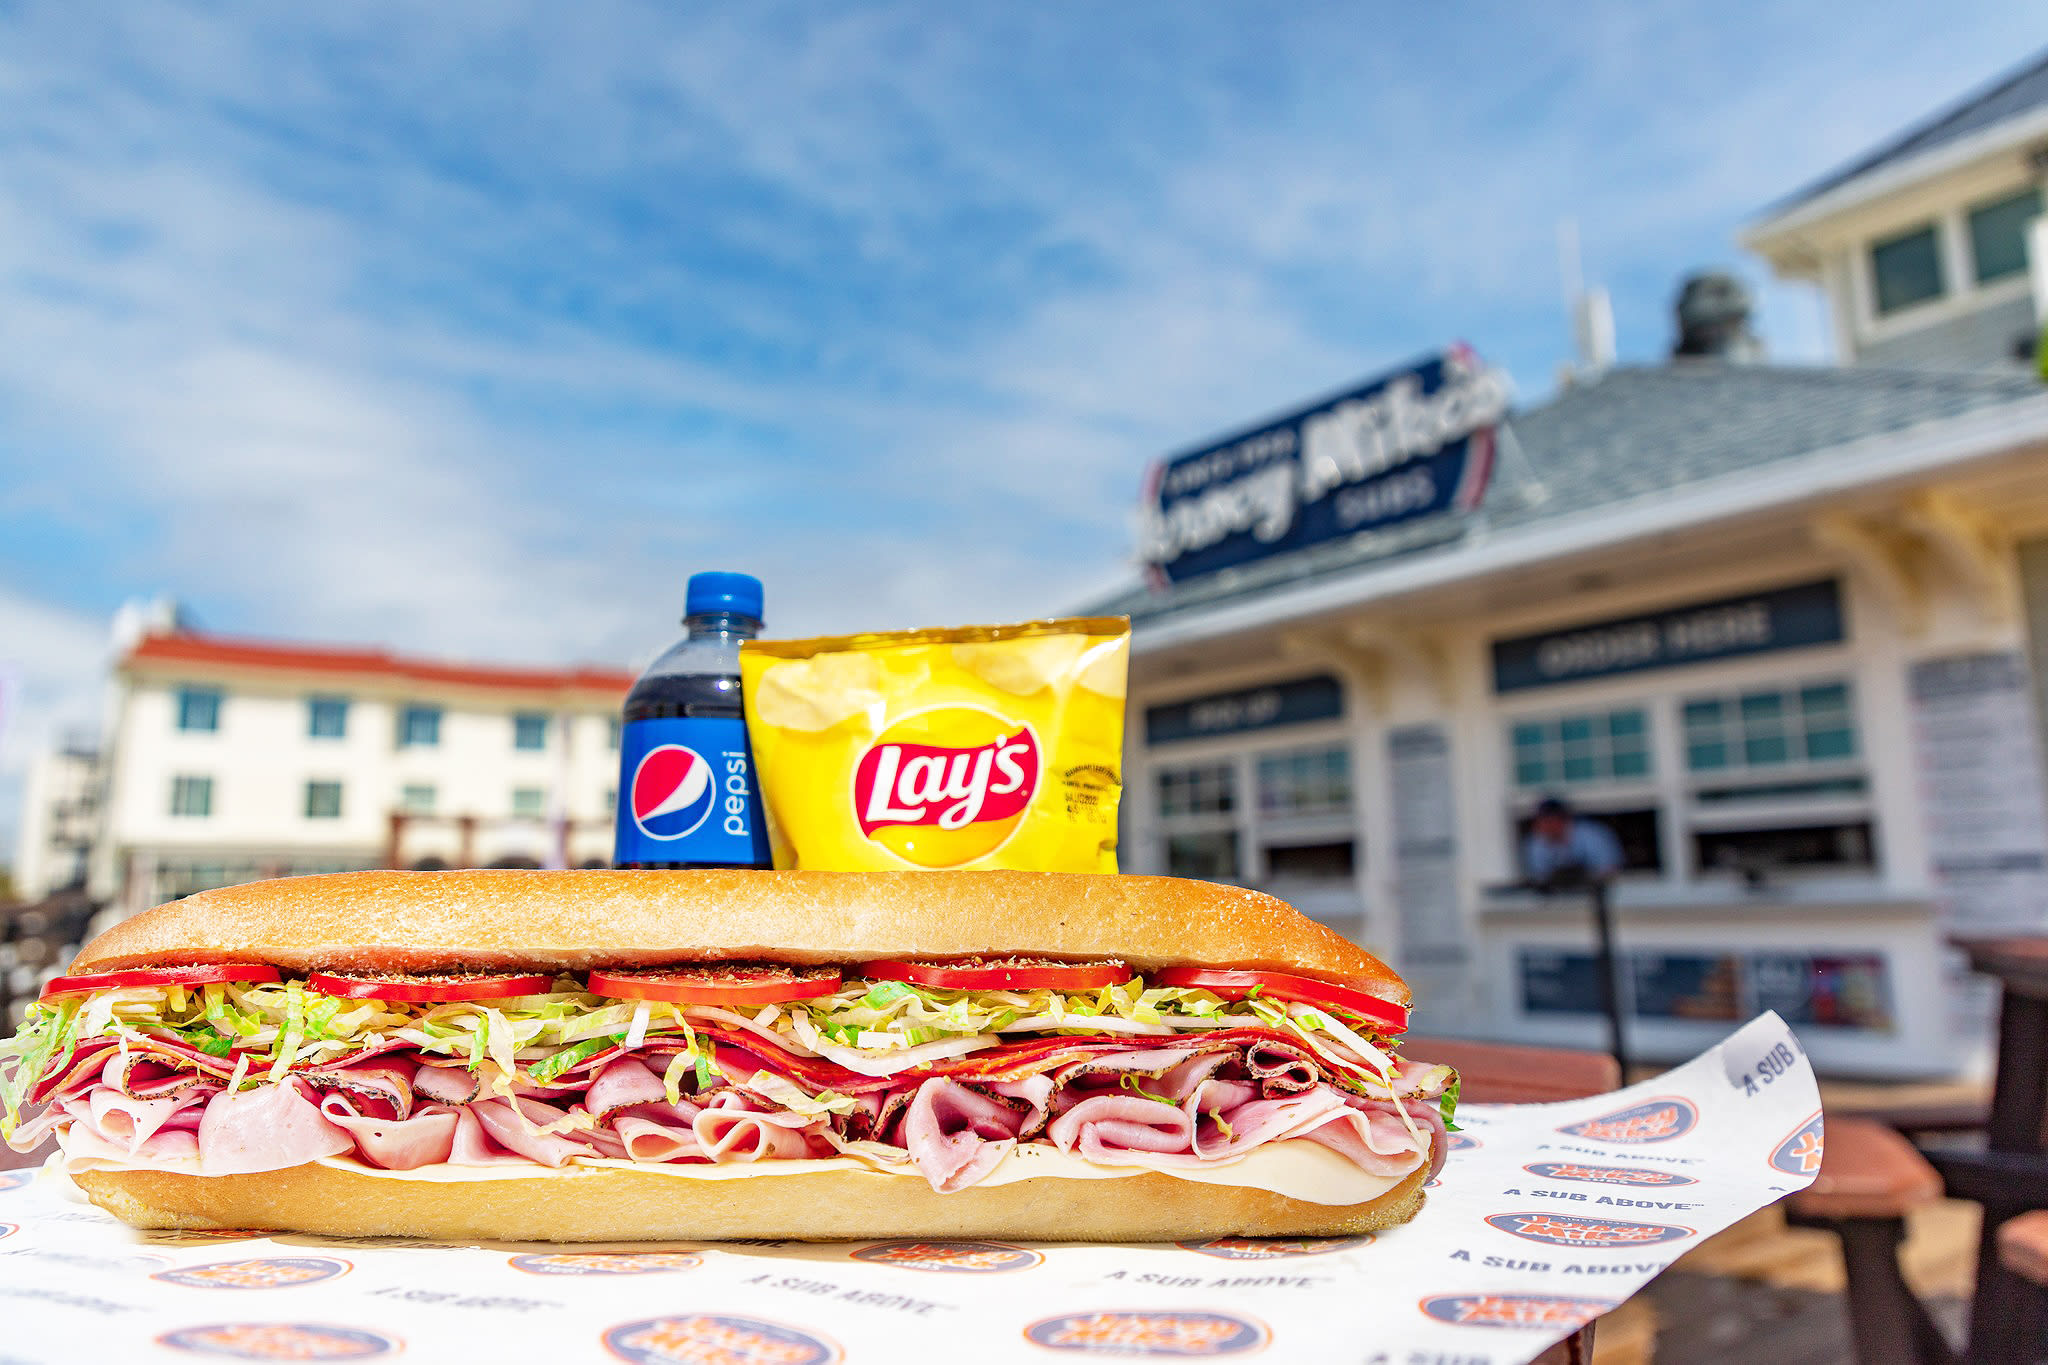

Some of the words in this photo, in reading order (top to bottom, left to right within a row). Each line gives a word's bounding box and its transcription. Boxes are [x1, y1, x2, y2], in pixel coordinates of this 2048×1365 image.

[722, 751, 751, 837] pepsi
[865, 734, 1030, 831] Lay's
[1743, 1074, 1760, 1097] A
[1757, 1042, 1796, 1084] SUB
[1503, 1188, 1521, 1196] A
[1530, 1190, 1588, 1202] SUB
[1595, 1195, 1692, 1211] ABOVE
[1449, 1249, 1471, 1262] A
[1482, 1256, 1552, 1273] SUB
